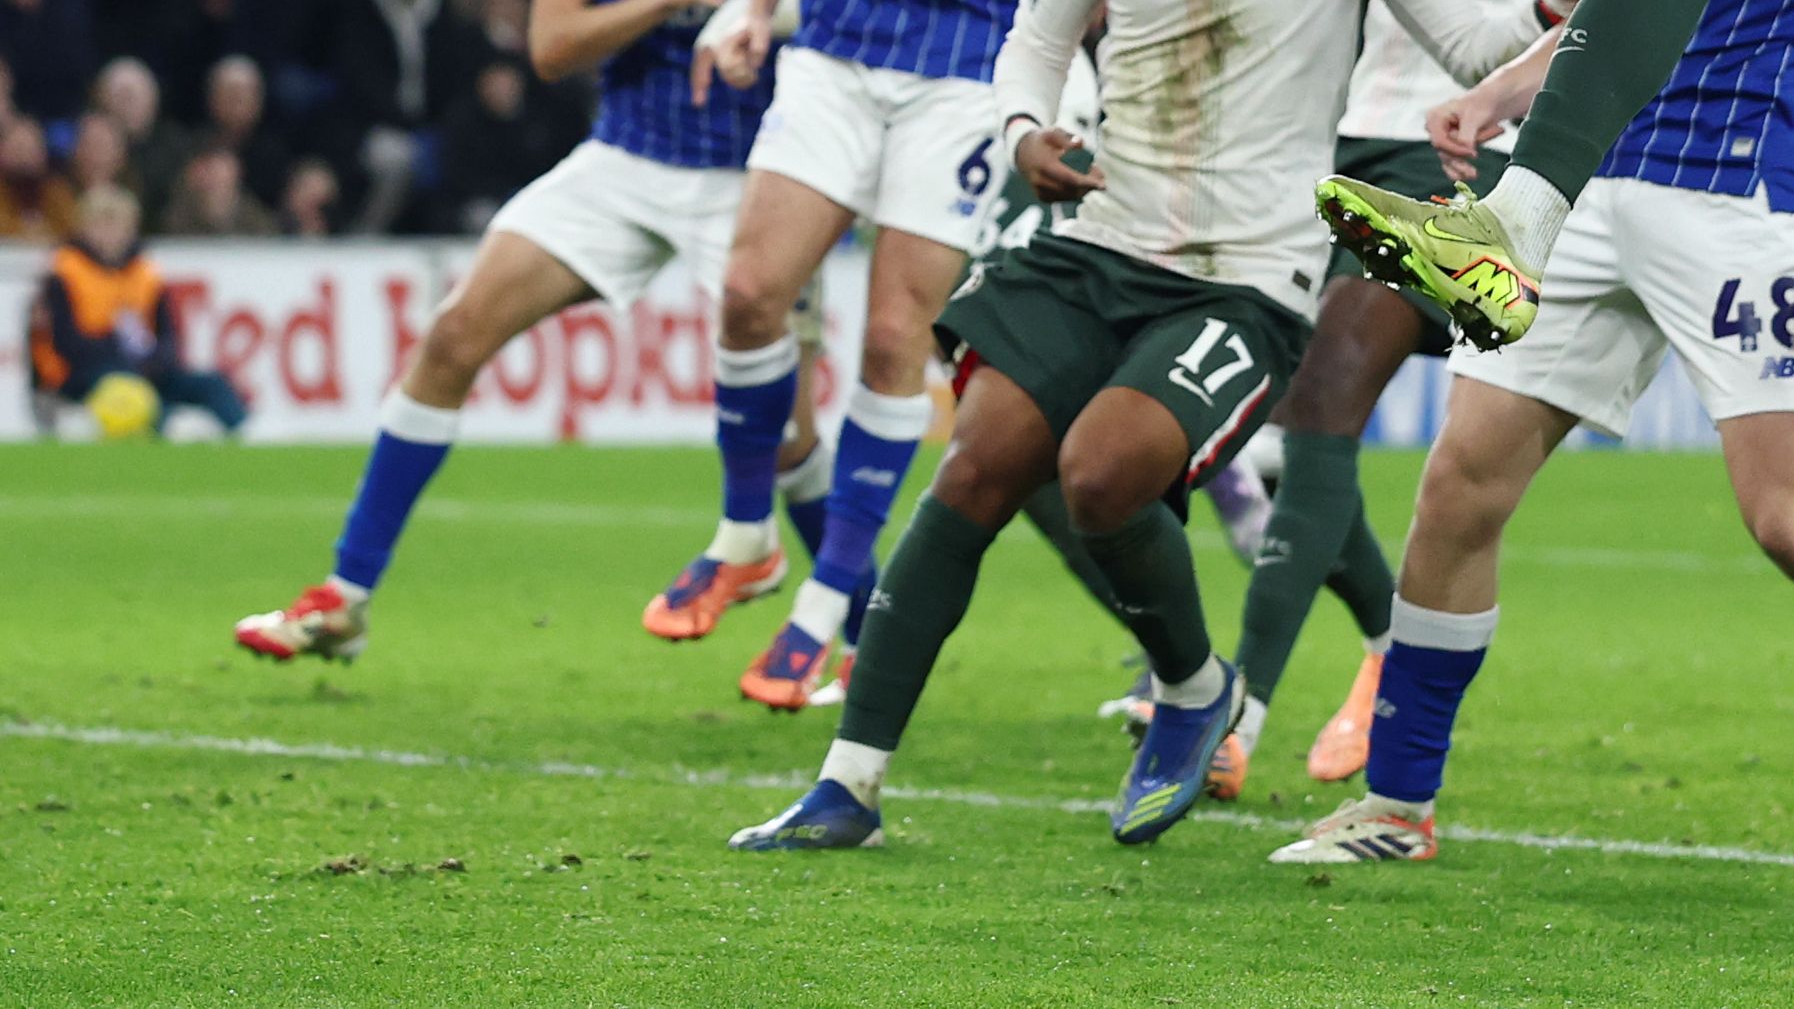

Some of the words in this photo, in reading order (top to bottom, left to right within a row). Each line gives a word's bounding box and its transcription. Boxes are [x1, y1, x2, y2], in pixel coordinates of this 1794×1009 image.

[1560, 27, 1588, 44] FC
[958, 138, 995, 196] 6
[380, 274, 838, 441] opki
[1174, 317, 1254, 395] 17
